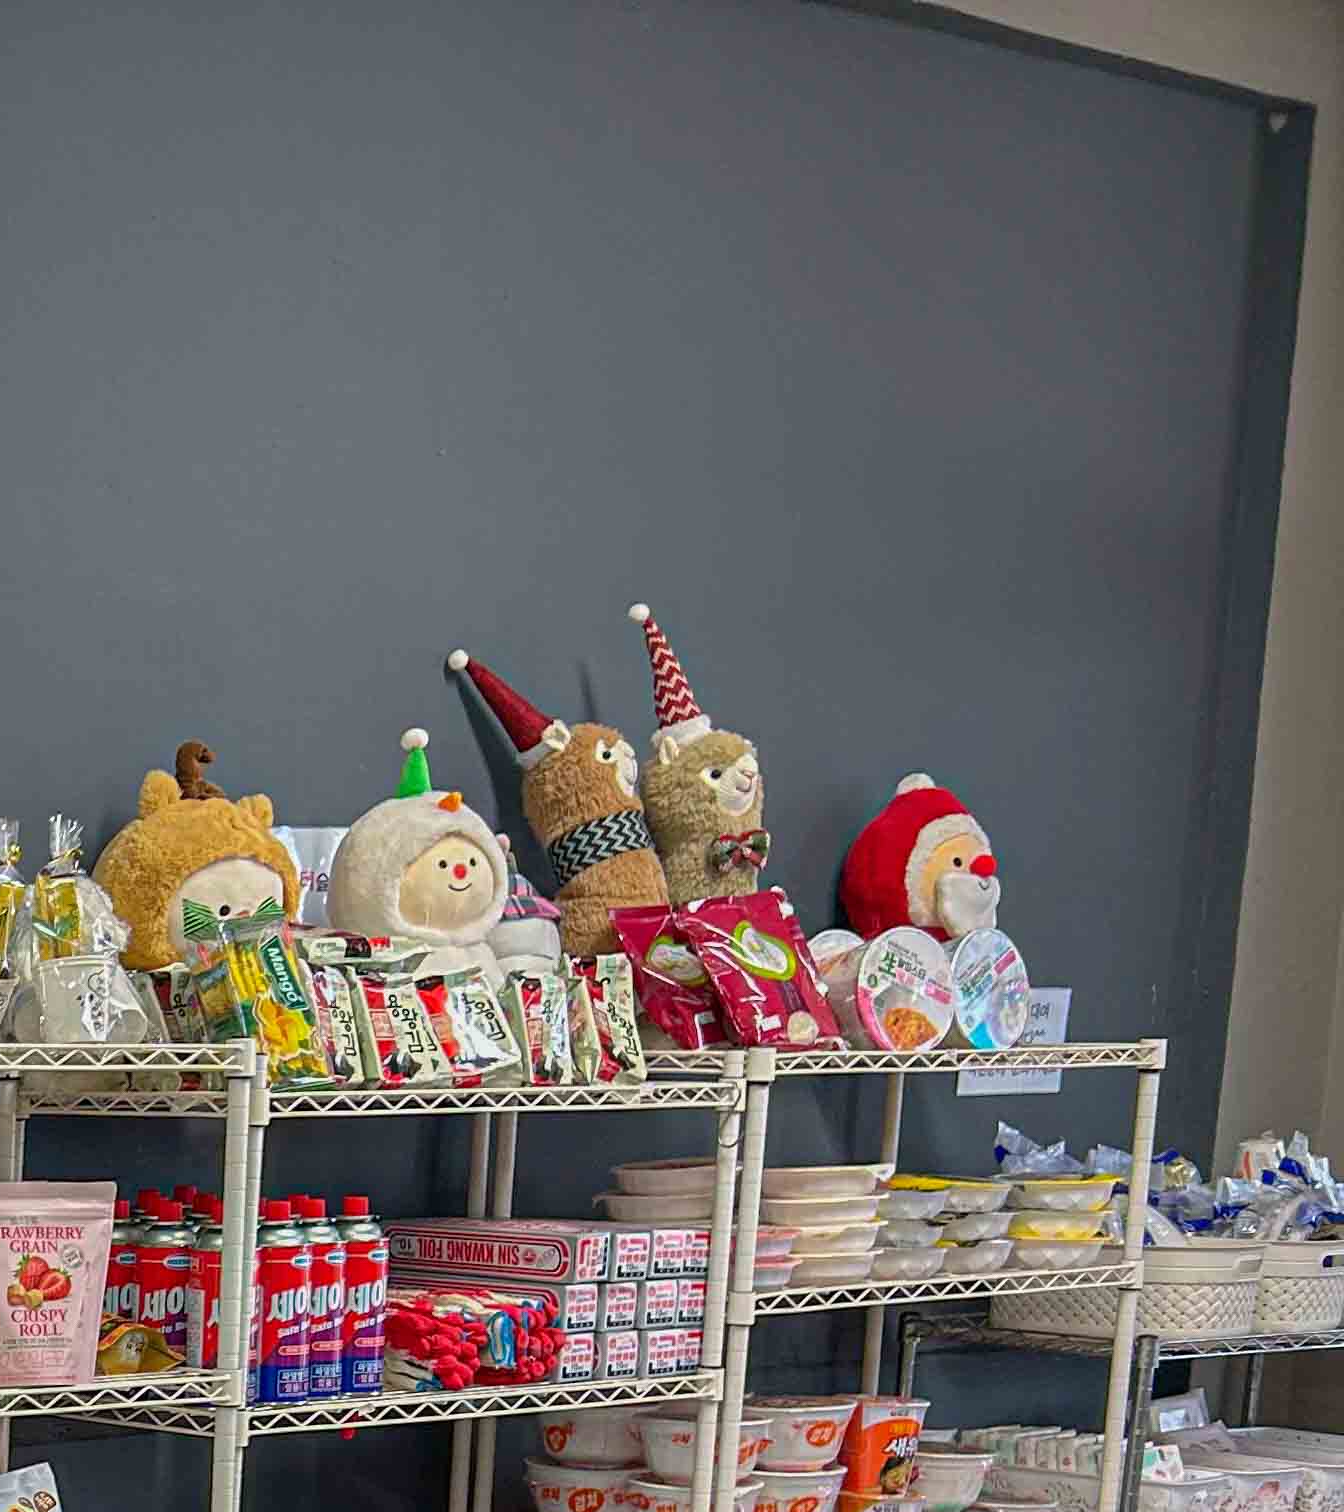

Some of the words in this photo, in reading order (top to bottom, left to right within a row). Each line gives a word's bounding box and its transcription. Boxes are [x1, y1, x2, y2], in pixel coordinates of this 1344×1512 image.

[265, 945, 303, 1007] Mango
[9, 1240, 58, 1254] GRAIN
[416, 1237, 443, 1259] FOIL
[448, 1239, 490, 1263] KWANG
[497, 1241, 521, 1265] SIN
[11, 1309, 67, 1324] CRISPY
[19, 1323, 63, 1337] ROLL
